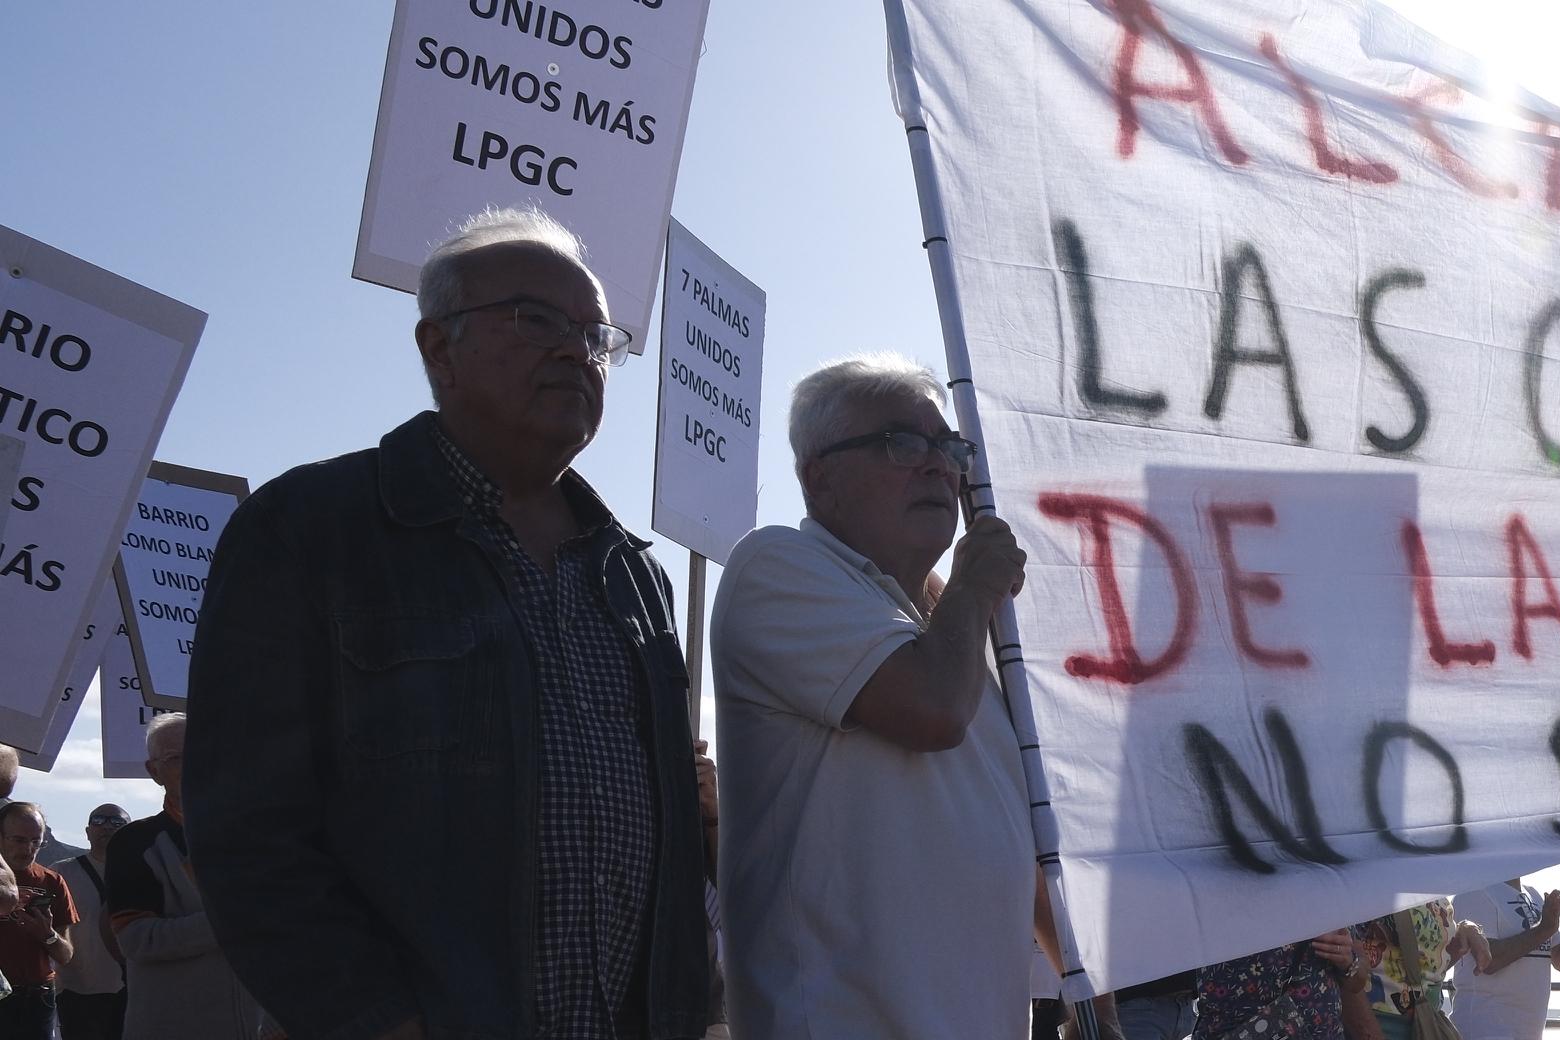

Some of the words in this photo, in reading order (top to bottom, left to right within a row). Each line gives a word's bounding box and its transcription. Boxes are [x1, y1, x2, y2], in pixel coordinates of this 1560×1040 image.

[469, 0, 633, 69] UNIDOS
[415, 36, 563, 112] SOMOS
[573, 90, 656, 145] MÁS
[452, 121, 578, 196] LPGC
[681, 268, 690, 291] 7
[693, 278, 750, 338] PALMAS
[1051, 217, 1430, 453] LAS
[686, 320, 741, 378] UNIDOS
[671, 358, 719, 407] SOMOS
[722, 393, 752, 428] MÁS
[685, 414, 727, 463] LPGC
[137, 502, 209, 532] BARRIO
[0, 543, 65, 592] ÁS
[1037, 491, 1311, 684] DE
[1182, 705, 1468, 875] NO
